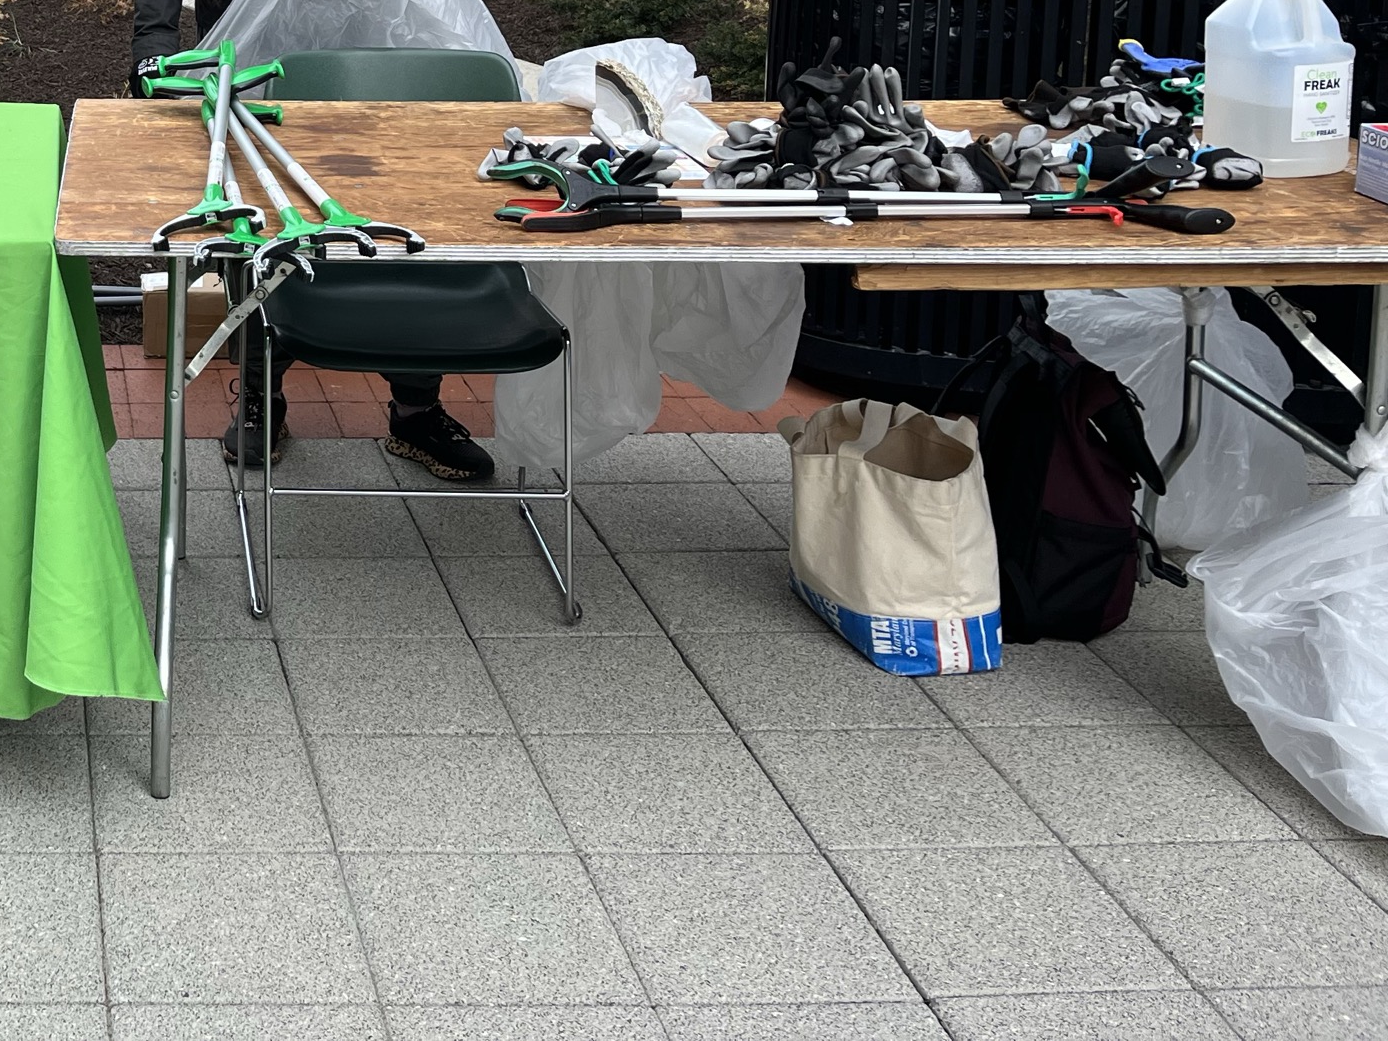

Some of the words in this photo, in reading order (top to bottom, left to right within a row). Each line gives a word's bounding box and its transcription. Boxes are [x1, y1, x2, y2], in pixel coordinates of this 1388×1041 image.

[1307, 69, 1337, 80] Clean
[1304, 78, 1340, 91] FREAK
[870, 619, 894, 655] MTA
